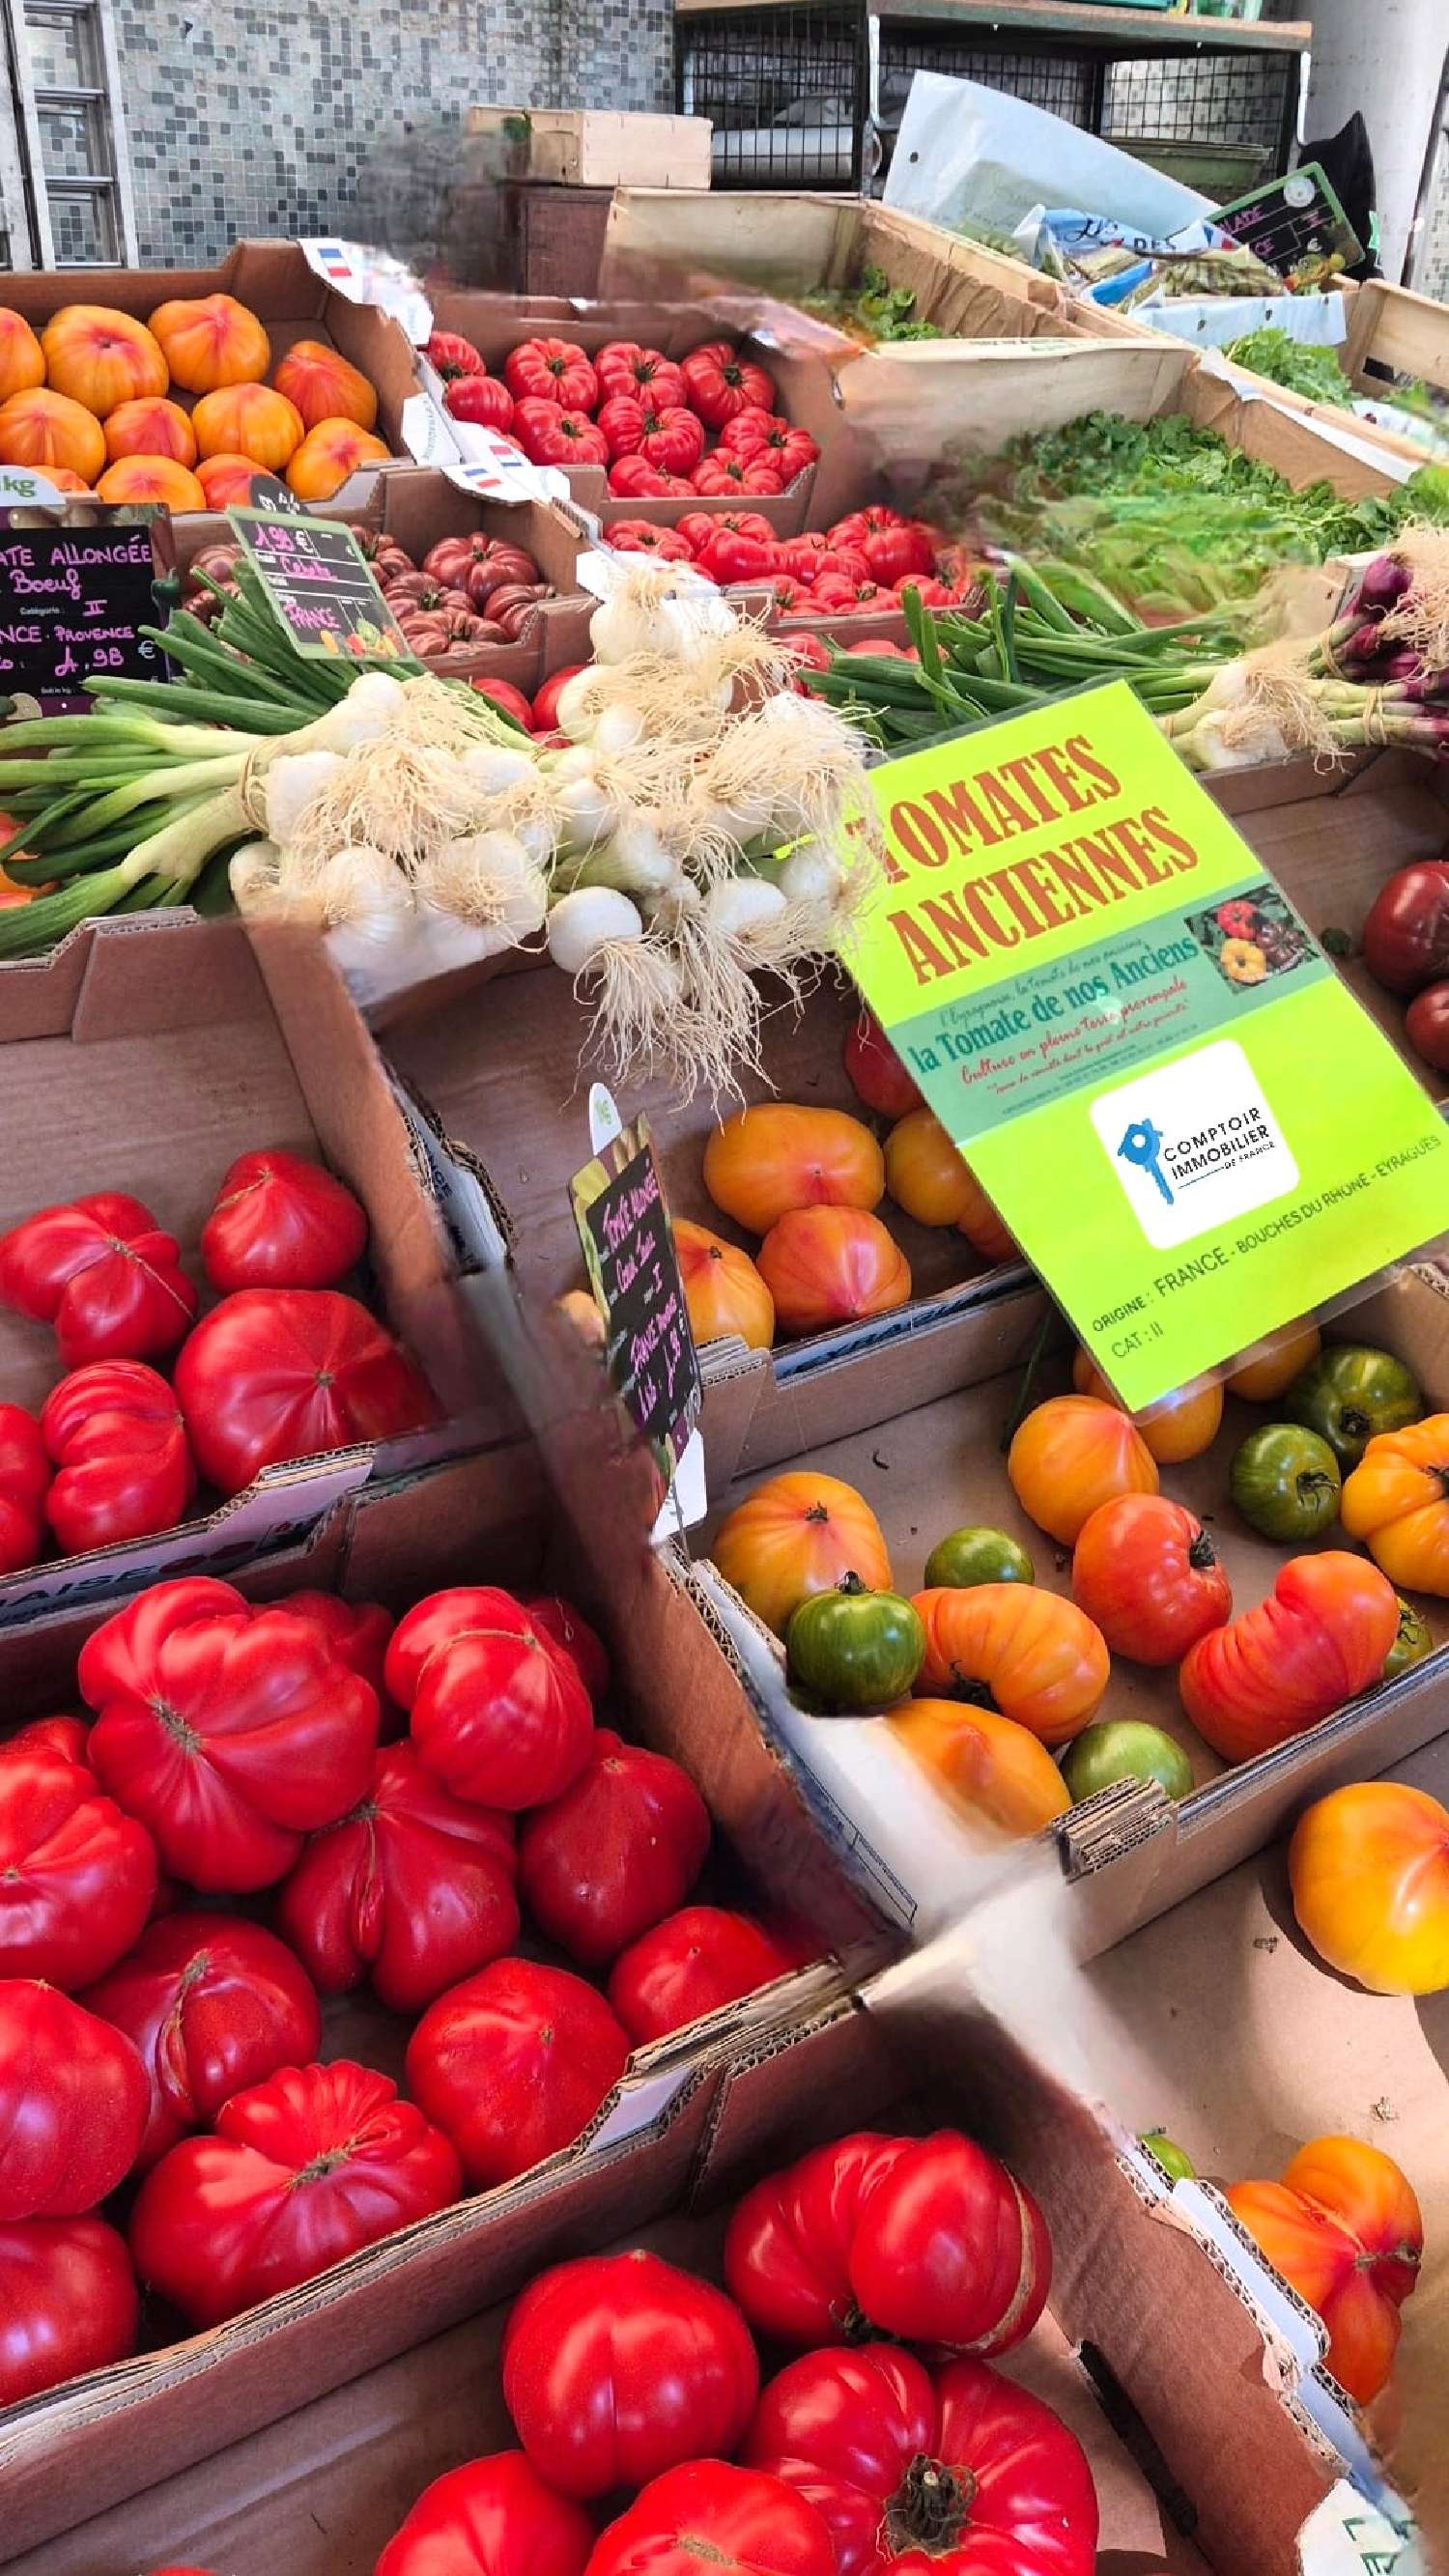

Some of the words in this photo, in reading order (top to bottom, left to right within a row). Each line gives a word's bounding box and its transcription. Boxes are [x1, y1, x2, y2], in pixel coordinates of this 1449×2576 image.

[50, 534, 152, 566] ALLONGÉE
[54, 624, 135, 643] PROVENCE
[137, 640, 156, 660] €
[886, 806, 1199, 985] ANCIENNES
[907, 1046, 943, 1074] la
[935, 1005, 1032, 1062] Tomate
[1032, 993, 1064, 1022] de
[1064, 975, 1110, 1009] nos
[1110, 937, 1199, 990] Anciens
[1093, 1296, 1148, 1333] ORIGINE
[1152, 1247, 1231, 1297] FRANCE
[1235, 1209, 1303, 1254] BOUCHES
[1300, 1199, 1324, 1219] DU
[1375, 1135, 1442, 1177] EYRAGUES
[1111, 1331, 1144, 1359] CAT
